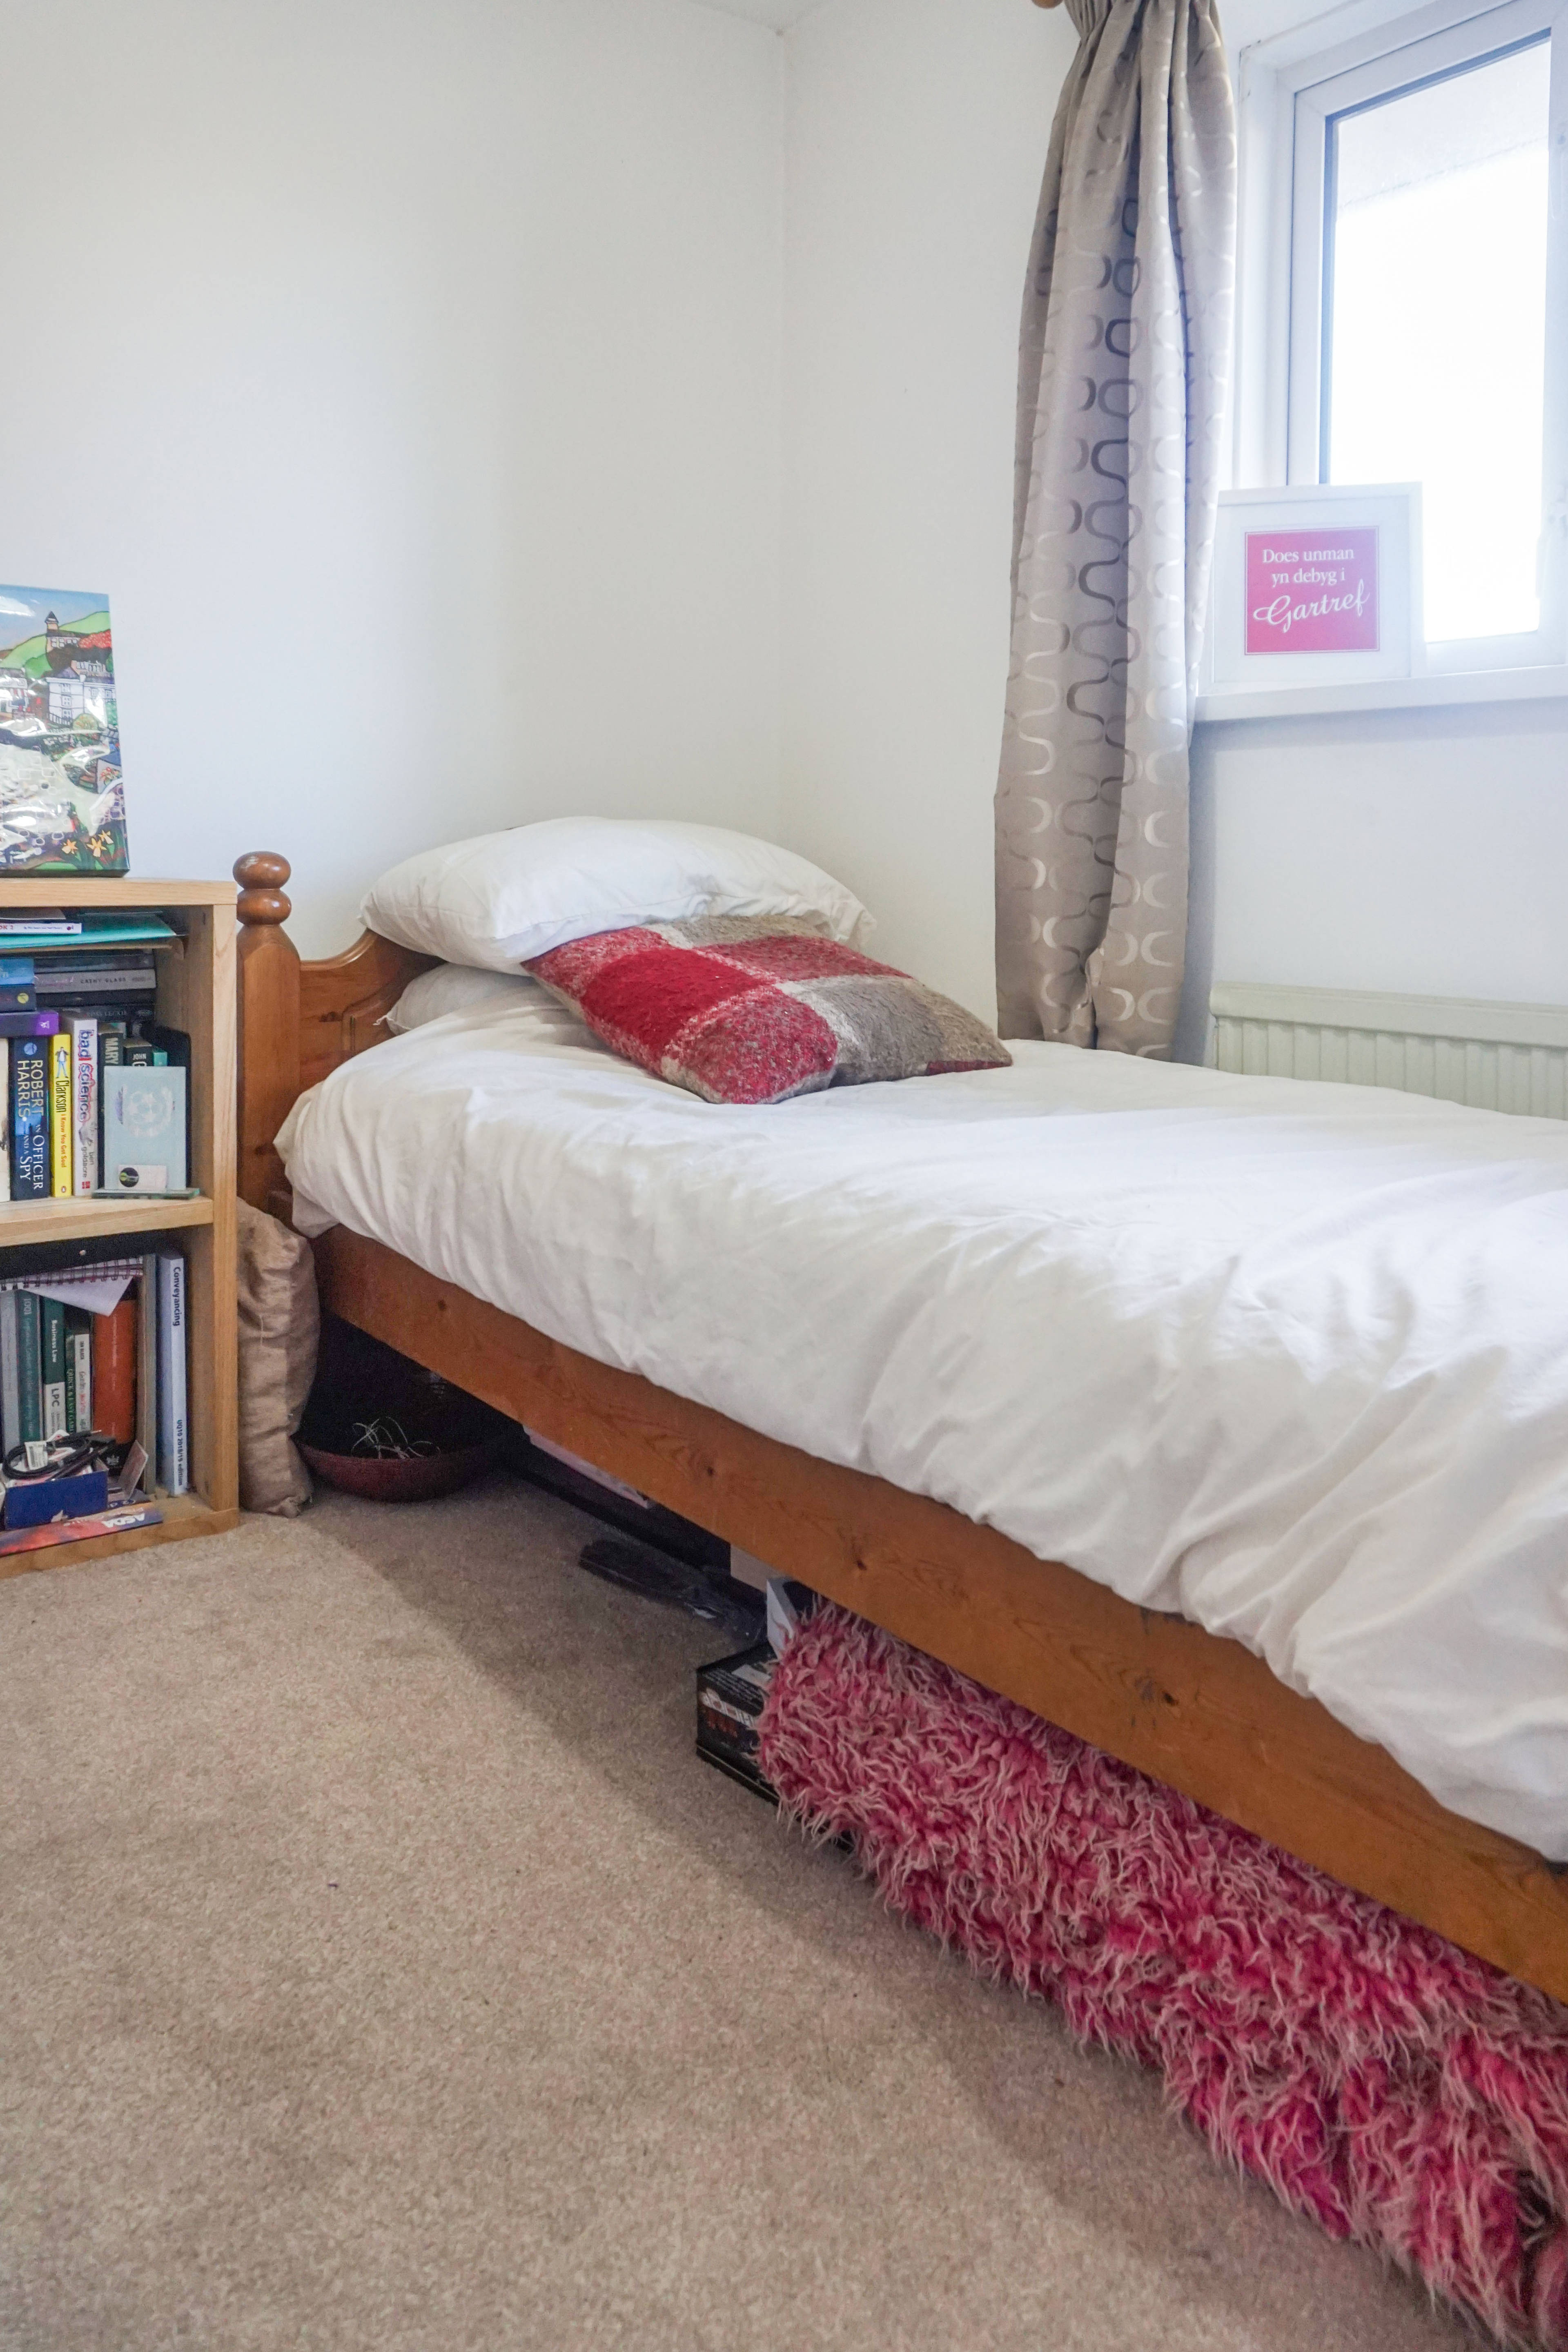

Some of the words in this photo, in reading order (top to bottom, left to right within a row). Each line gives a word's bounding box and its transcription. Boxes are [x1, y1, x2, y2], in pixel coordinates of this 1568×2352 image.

[1262, 549, 1299, 564] Does
[1303, 548, 1354, 561] unman
[1272, 572, 1290, 587] yn
[1294, 568, 1337, 586] debyg
[1341, 567, 1346, 581] i
[1253, 579, 1370, 633] Gartref
[80, 1029, 94, 1058] bad
[105, 1038, 118, 1064] MARY
[18, 1060, 31, 1117] HARRIS
[31, 1060, 44, 1116] ROBERT
[56, 1080, 70, 1113] Clarkson
[79, 1064, 91, 1122] science
[20, 1156, 33, 1180] SPY
[33, 1135, 45, 1190] OFFICER
[81, 1147, 89, 1178] goldacre
[172, 1267, 182, 1326] Conveyancing
[51, 1388, 60, 1407] LPC
[101, 1513, 145, 1528] ASDA
